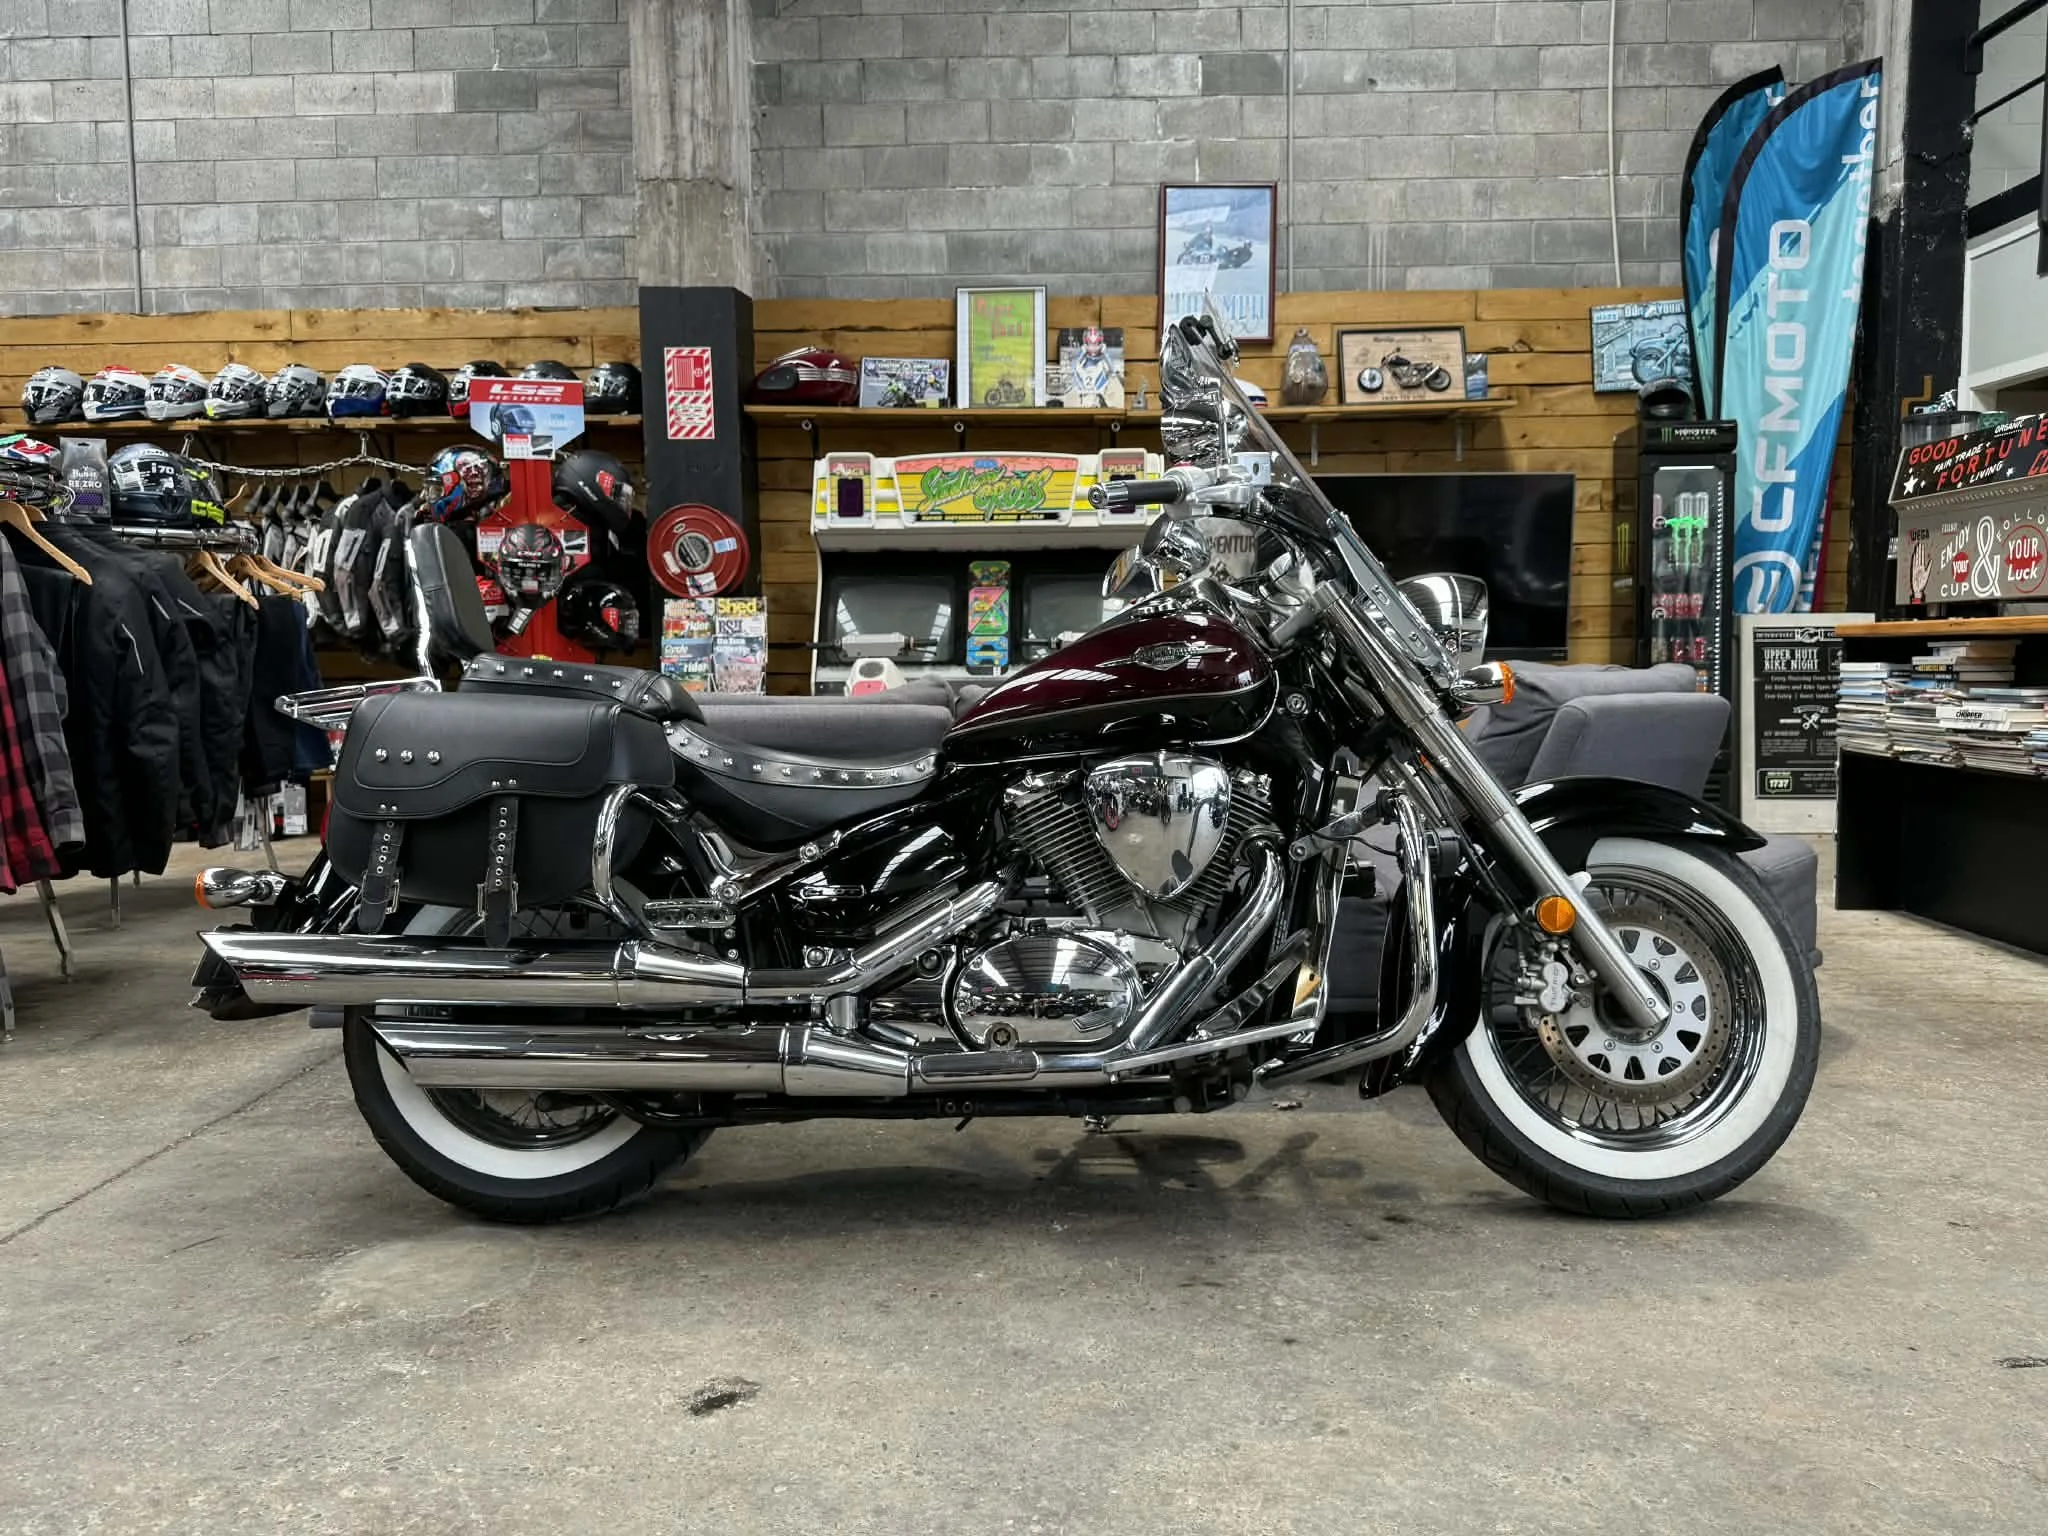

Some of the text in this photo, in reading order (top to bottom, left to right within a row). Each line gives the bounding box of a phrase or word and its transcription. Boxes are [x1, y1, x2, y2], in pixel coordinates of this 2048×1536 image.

[1751, 218, 1812, 533] CFMOTO
[489, 384, 564, 396] LS2
[1674, 428, 1717, 436] MONSTER
[1909, 439, 1959, 465] GOOD
[1954, 443, 1984, 464] TRADE
[1969, 460, 2004, 484] LIVING
[1911, 529, 1930, 541] WEGA
[1996, 508, 2048, 542] FOLLO
[1941, 521, 1971, 569] ENJOY
[2008, 537, 2038, 561] YOUR
[1971, 515, 2002, 597] &
[2007, 561, 2038, 581] Luck
[1940, 582, 1970, 597] CUP
[719, 598, 757, 615] Shed
[1764, 648, 1818, 660] UPPER HUTT
[1791, 660, 1819, 672] NIGHT
[1955, 711, 1983, 719] CHOPPER
